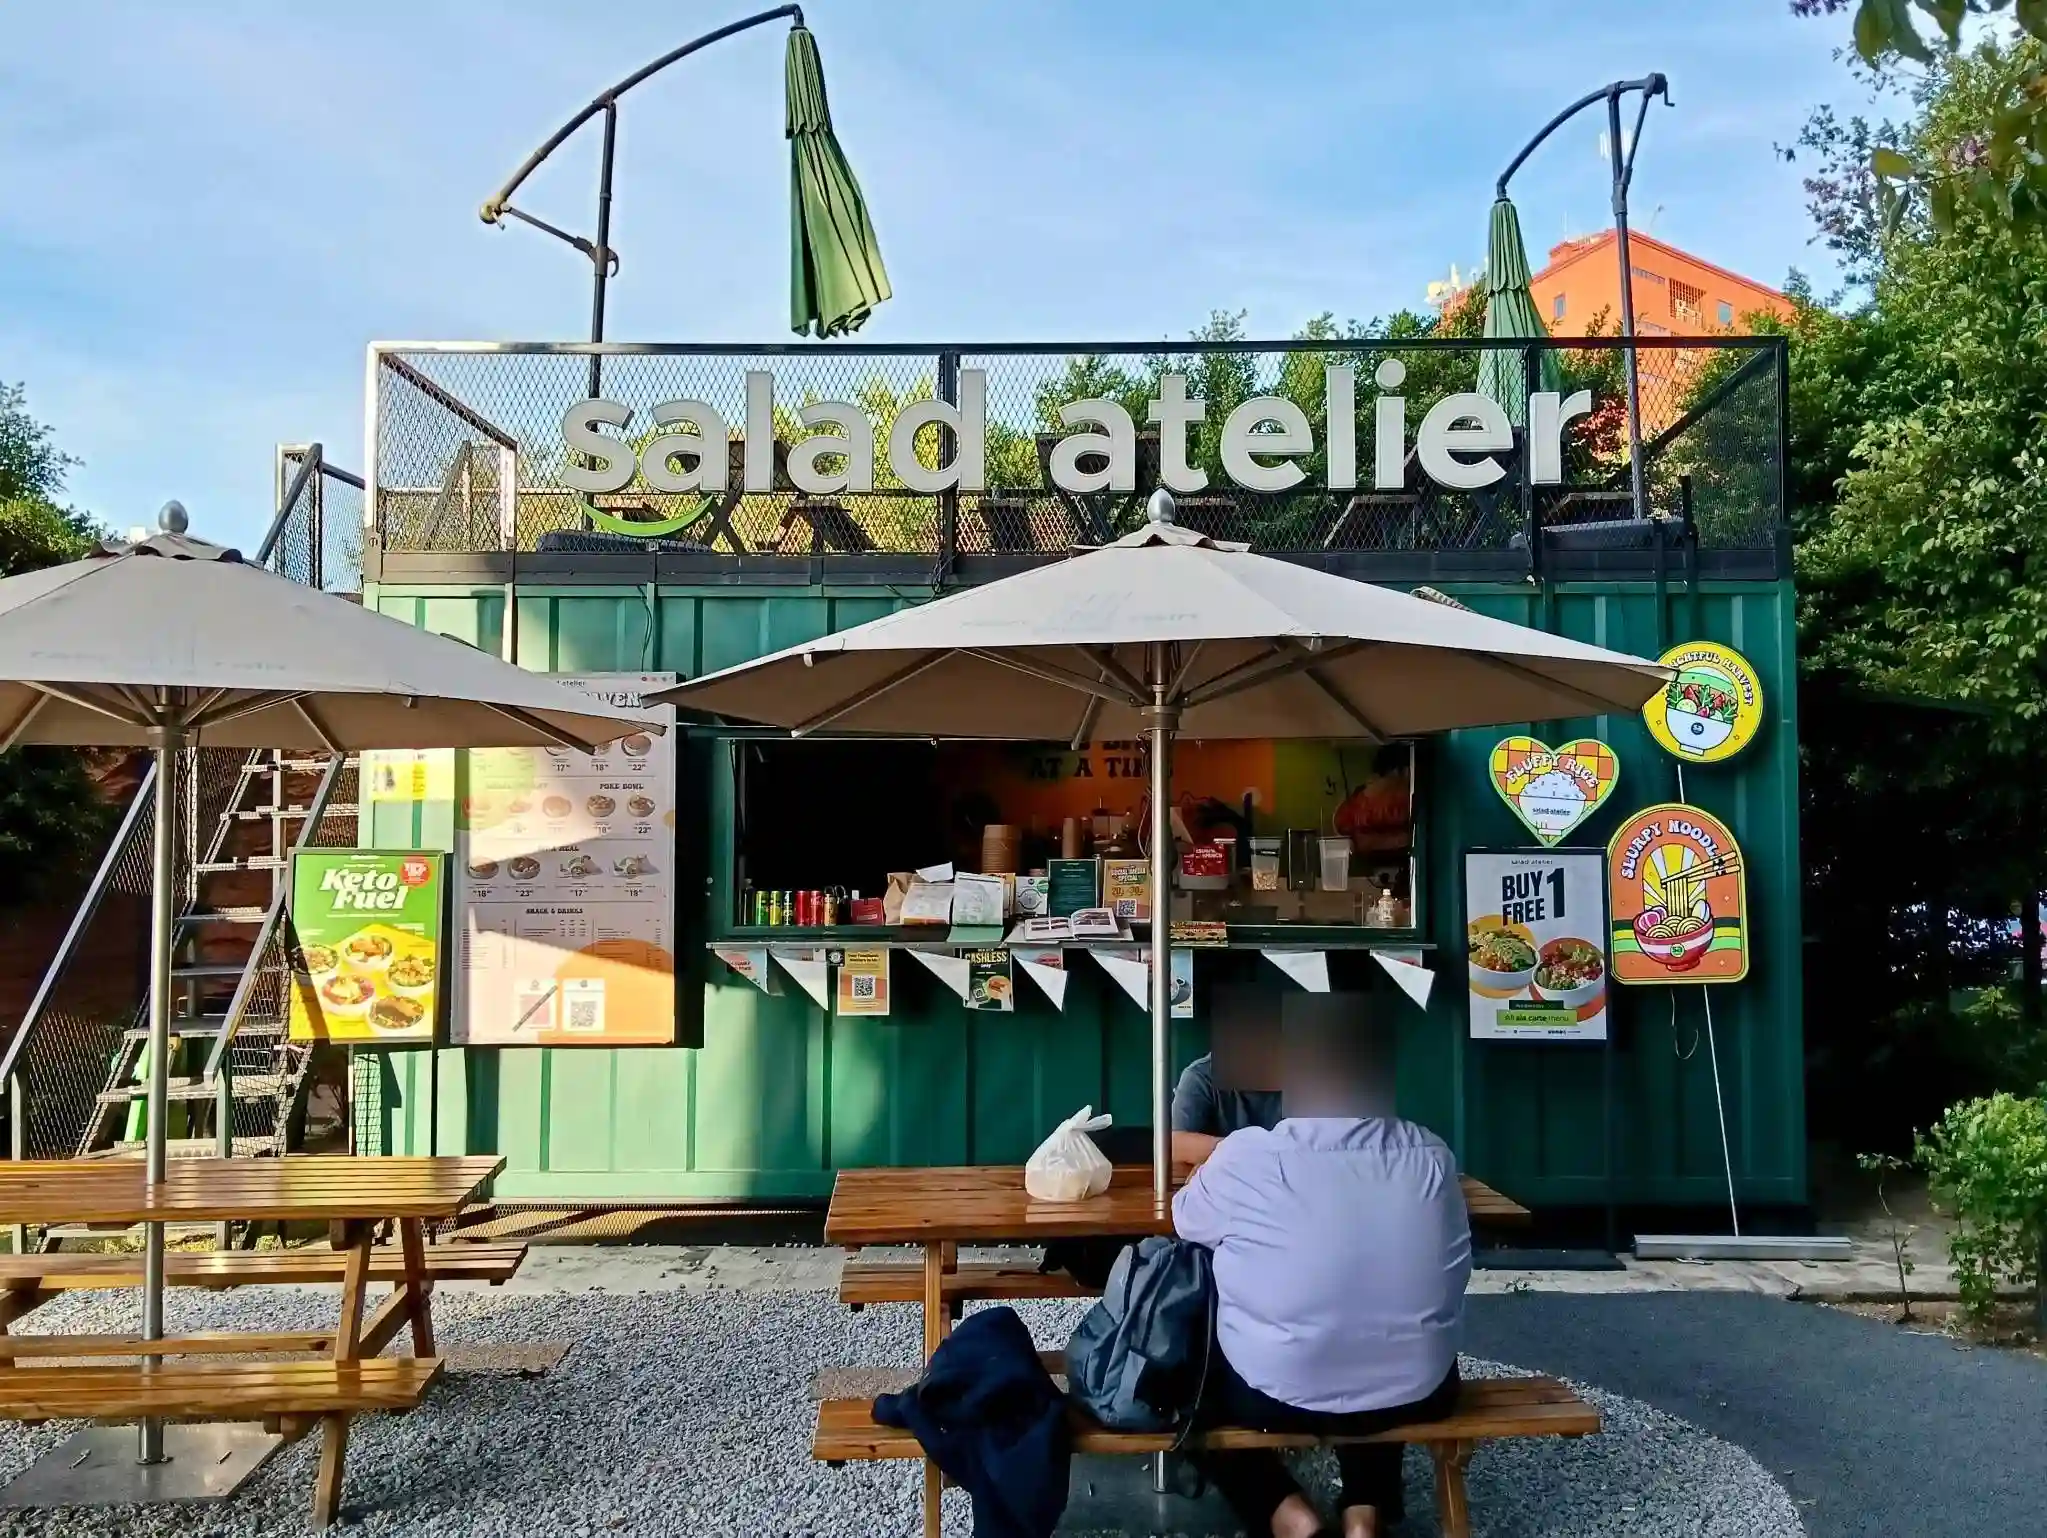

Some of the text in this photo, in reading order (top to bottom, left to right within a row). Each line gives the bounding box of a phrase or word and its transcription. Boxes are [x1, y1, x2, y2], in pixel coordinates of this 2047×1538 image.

[558, 358, 1591, 494] salad atelier
[1671, 651, 1753, 706] IGHTFUL HARVEST
[1031, 757, 1062, 779] AT
[1074, 757, 1094, 778] A
[1505, 753, 1600, 789] FLUFFY RICE
[1620, 819, 1720, 880] SLURPY NOODL
[319, 867, 399, 891] Keto
[1502, 867, 1565, 919] BUY 1
[331, 885, 409, 910] Fuel
[1502, 898, 1545, 926] FREE
[964, 951, 1008, 964] CASHLESS
